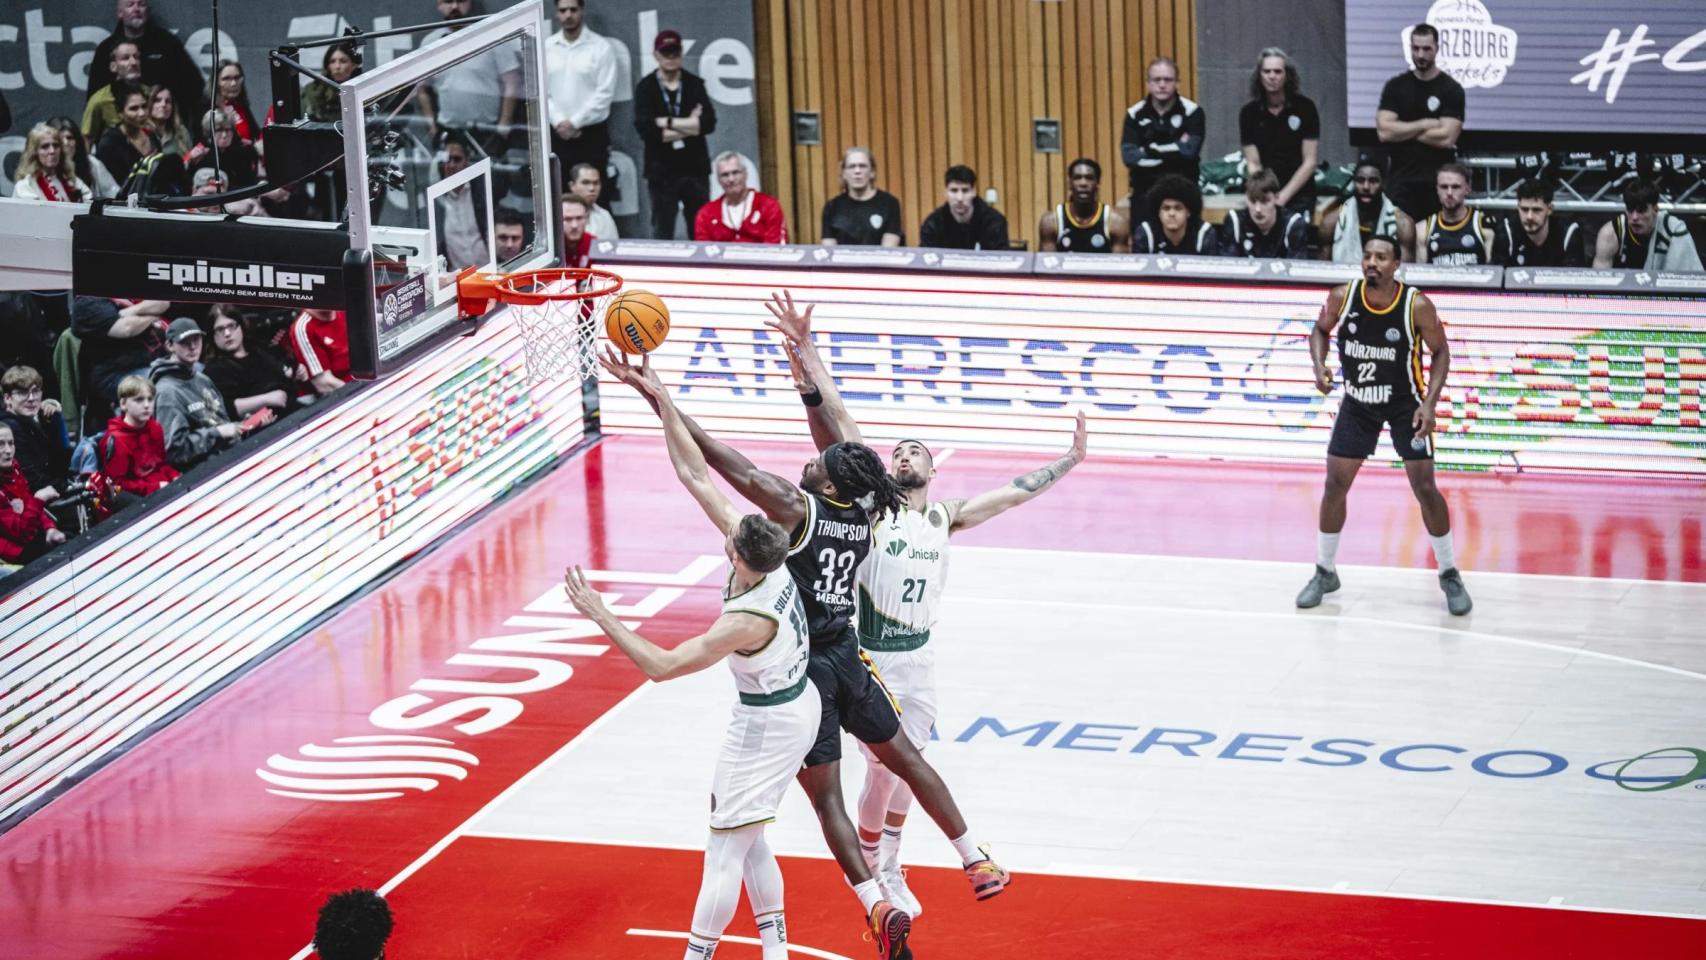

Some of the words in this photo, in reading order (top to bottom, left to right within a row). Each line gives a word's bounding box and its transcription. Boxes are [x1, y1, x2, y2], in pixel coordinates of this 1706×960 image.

[1441, 28, 1509, 59] RZBURG
[147, 260, 326, 291] spindler
[182, 285, 235, 295] WILLKOMMEN
[236, 289, 257, 297] BEIM
[258, 291, 290, 299] BESTEN
[1344, 339, 1397, 361] WÜRZBURG
[1357, 361, 1377, 384] 22
[1345, 379, 1393, 404] KNAUF
[817, 519, 869, 542] THOMPSON
[908, 548, 940, 563] Unicaja
[813, 547, 856, 595] 32
[901, 578, 927, 603] 27
[368, 555, 728, 736] SUNEL
[928, 716, 1570, 779] MERESCO
